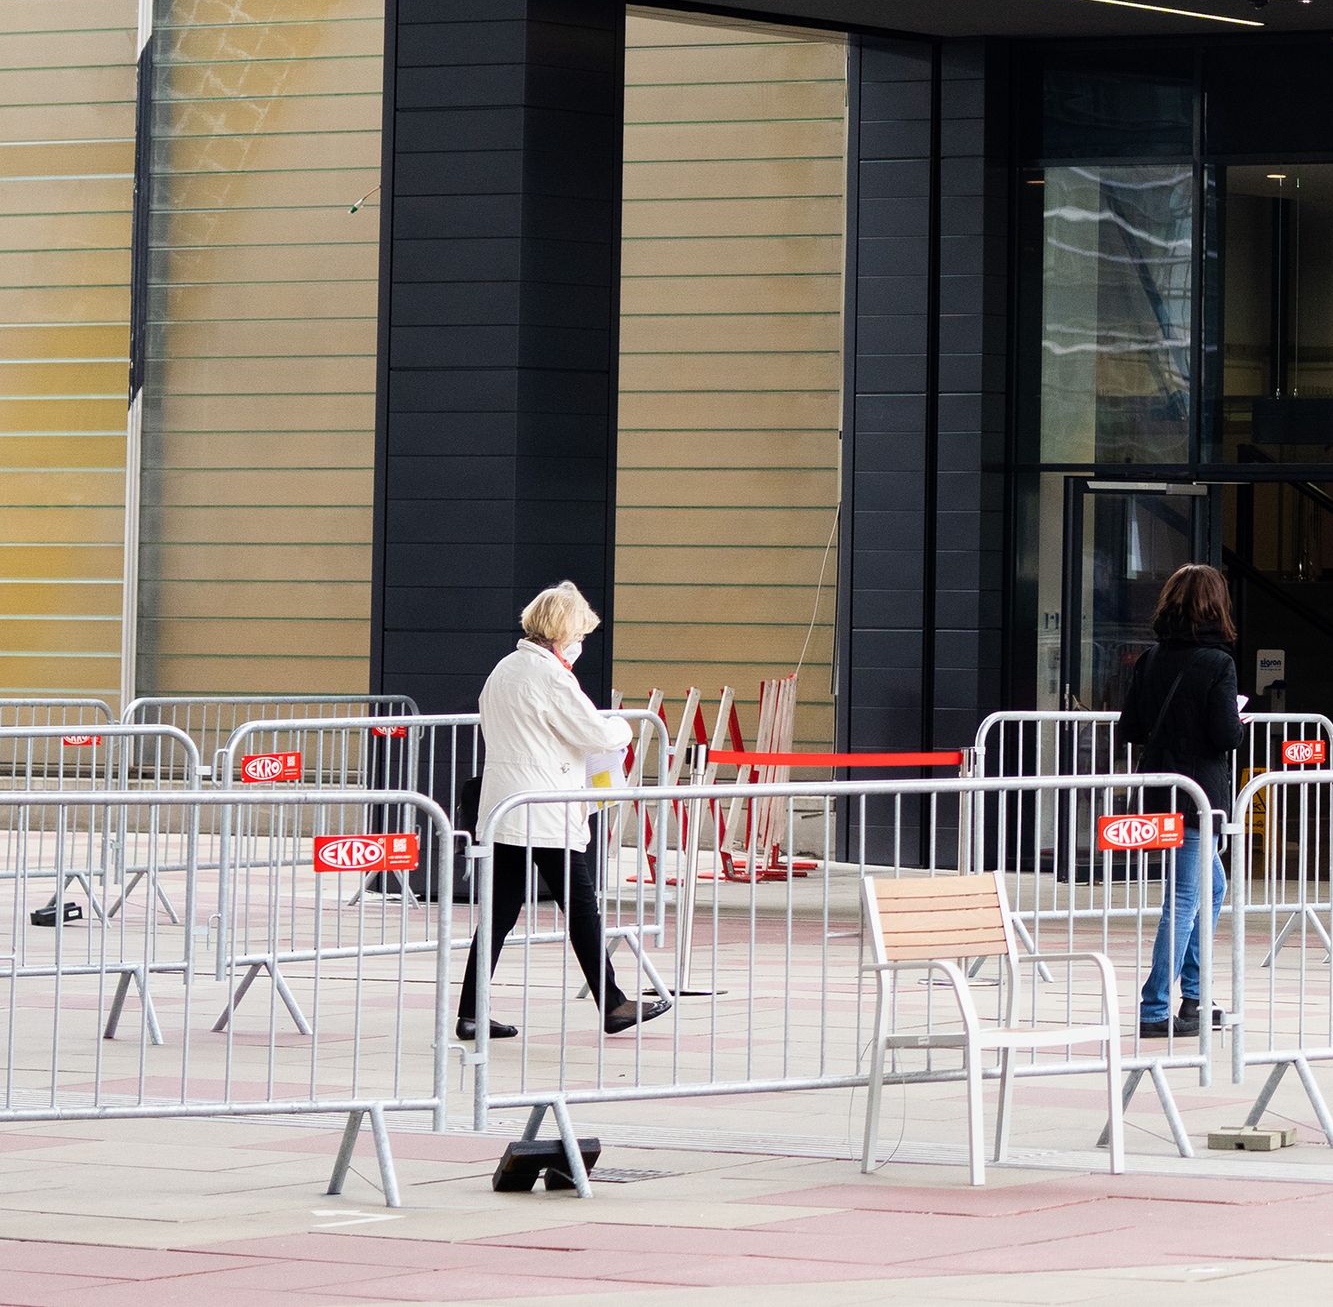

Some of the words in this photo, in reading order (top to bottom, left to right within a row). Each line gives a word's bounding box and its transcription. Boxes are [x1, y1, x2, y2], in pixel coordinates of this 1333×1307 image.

[1287, 745, 1311, 760] EKRO
[248, 759, 280, 778] EKRO
[1106, 821, 1155, 843] EKRO
[322, 841, 380, 866] EKRO
